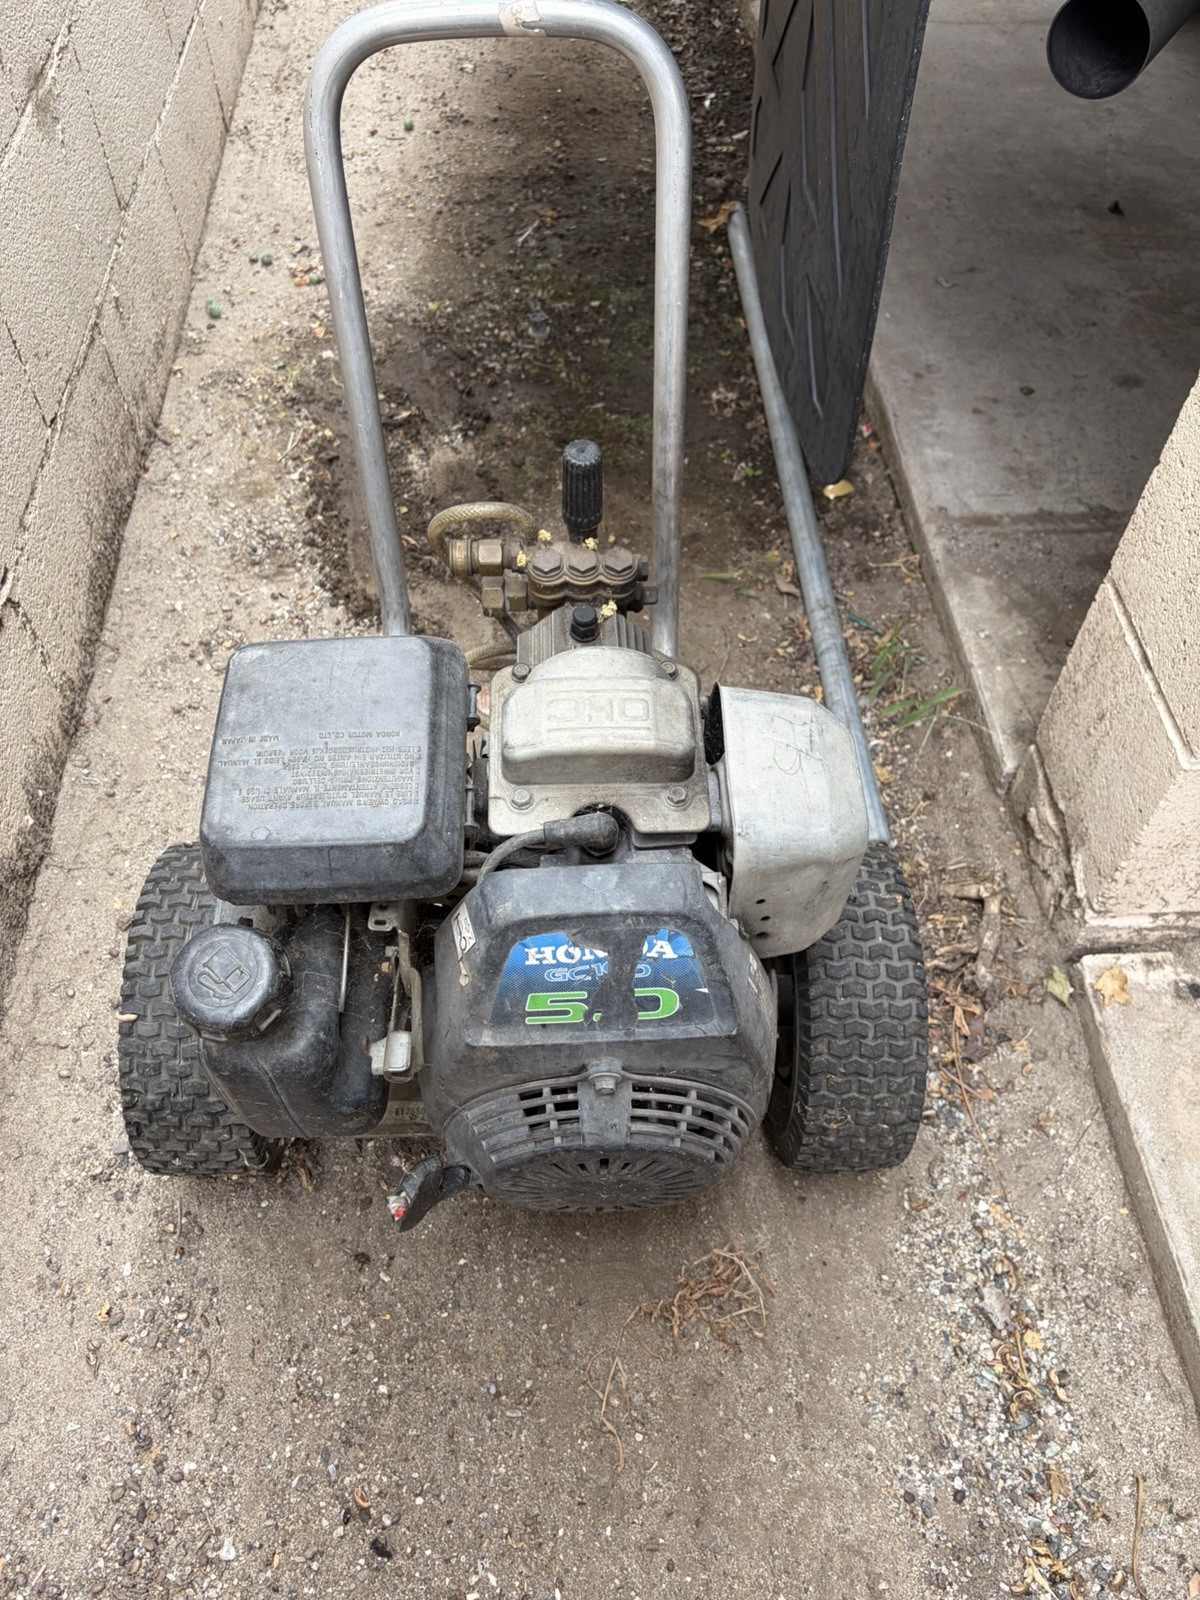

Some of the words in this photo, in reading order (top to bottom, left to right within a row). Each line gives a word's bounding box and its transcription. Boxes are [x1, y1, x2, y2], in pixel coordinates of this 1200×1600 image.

[260, 735, 280, 743] MADE
[289, 748, 308, 756] VOOR
[525, 940, 678, 966] HONA
